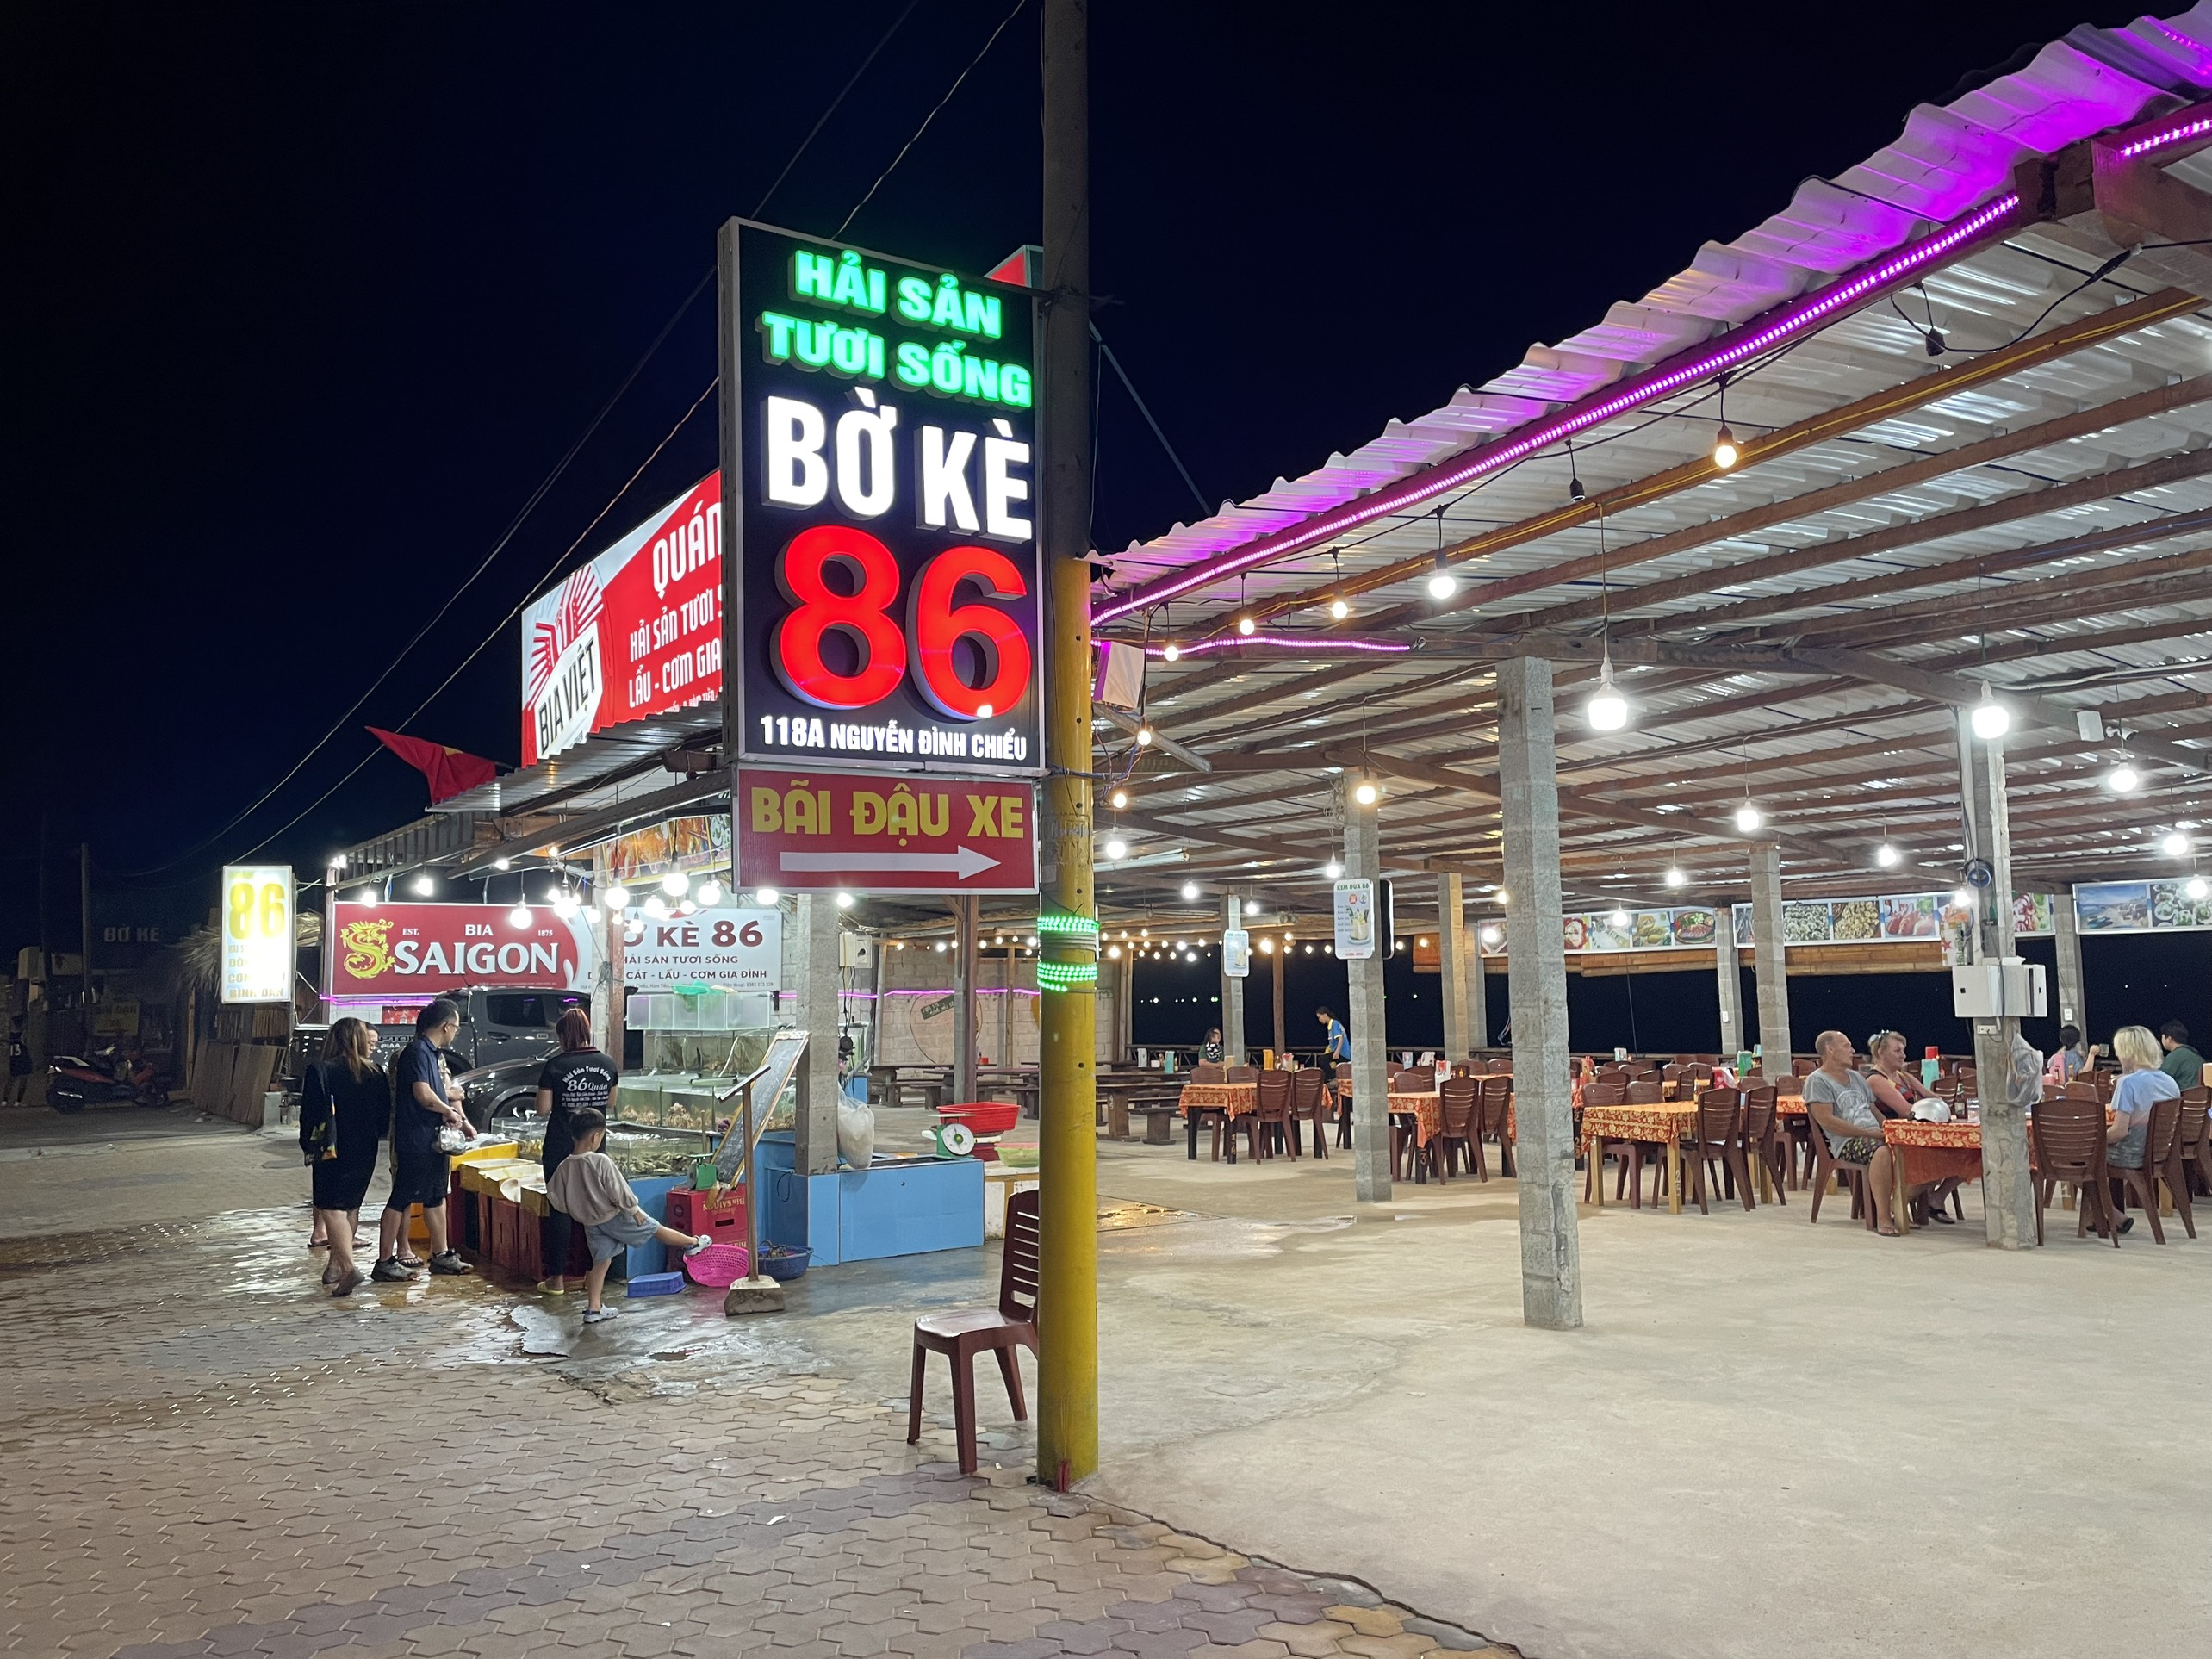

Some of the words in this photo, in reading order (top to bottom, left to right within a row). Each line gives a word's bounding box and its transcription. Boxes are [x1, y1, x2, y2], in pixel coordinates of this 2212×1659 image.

[794, 250, 886, 314] HẢI
[896, 273, 1002, 339] SẢN
[761, 311, 885, 380] TƯƠI
[896, 340, 1033, 408] SỐNG
[767, 387, 898, 517] BỜ
[921, 419, 1033, 541] KÈ
[630, 619, 652, 662] HẢI
[652, 606, 679, 651] SẢN
[680, 587, 714, 637] TƯƠI
[777, 525, 1032, 718] 86
[662, 651, 693, 694] CƠM
[696, 637, 723, 679] GIA
[538, 685, 564, 755] BIA
[562, 636, 595, 723] VIỆT
[760, 715, 826, 749] 118A
[830, 719, 915, 755] NGUYỄN
[917, 725, 966, 757] ĐÌNH
[971, 727, 1028, 761] CHIỂU
[750, 779, 832, 836] BÃI
[849, 782, 950, 847] ĐẬU
[966, 794, 1025, 839] XE
[228, 882, 286, 941] 86
[402, 928, 420, 936] EST.
[464, 923, 494, 936] BIA
[656, 920, 700, 948] KÈ
[711, 919, 764, 948] 86
[393, 940, 559, 976] SAIGON
[625, 969, 648, 979] CÁT
[690, 970, 717, 979] CƠM
[719, 971, 738, 979] GIA
[741, 969, 767, 979] ĐÌNH
[644, 953, 668, 964] SẢN
[672, 954, 702, 964] TƯƠI
[705, 953, 739, 964] SỐNG
[567, 1077, 587, 1092] 86
